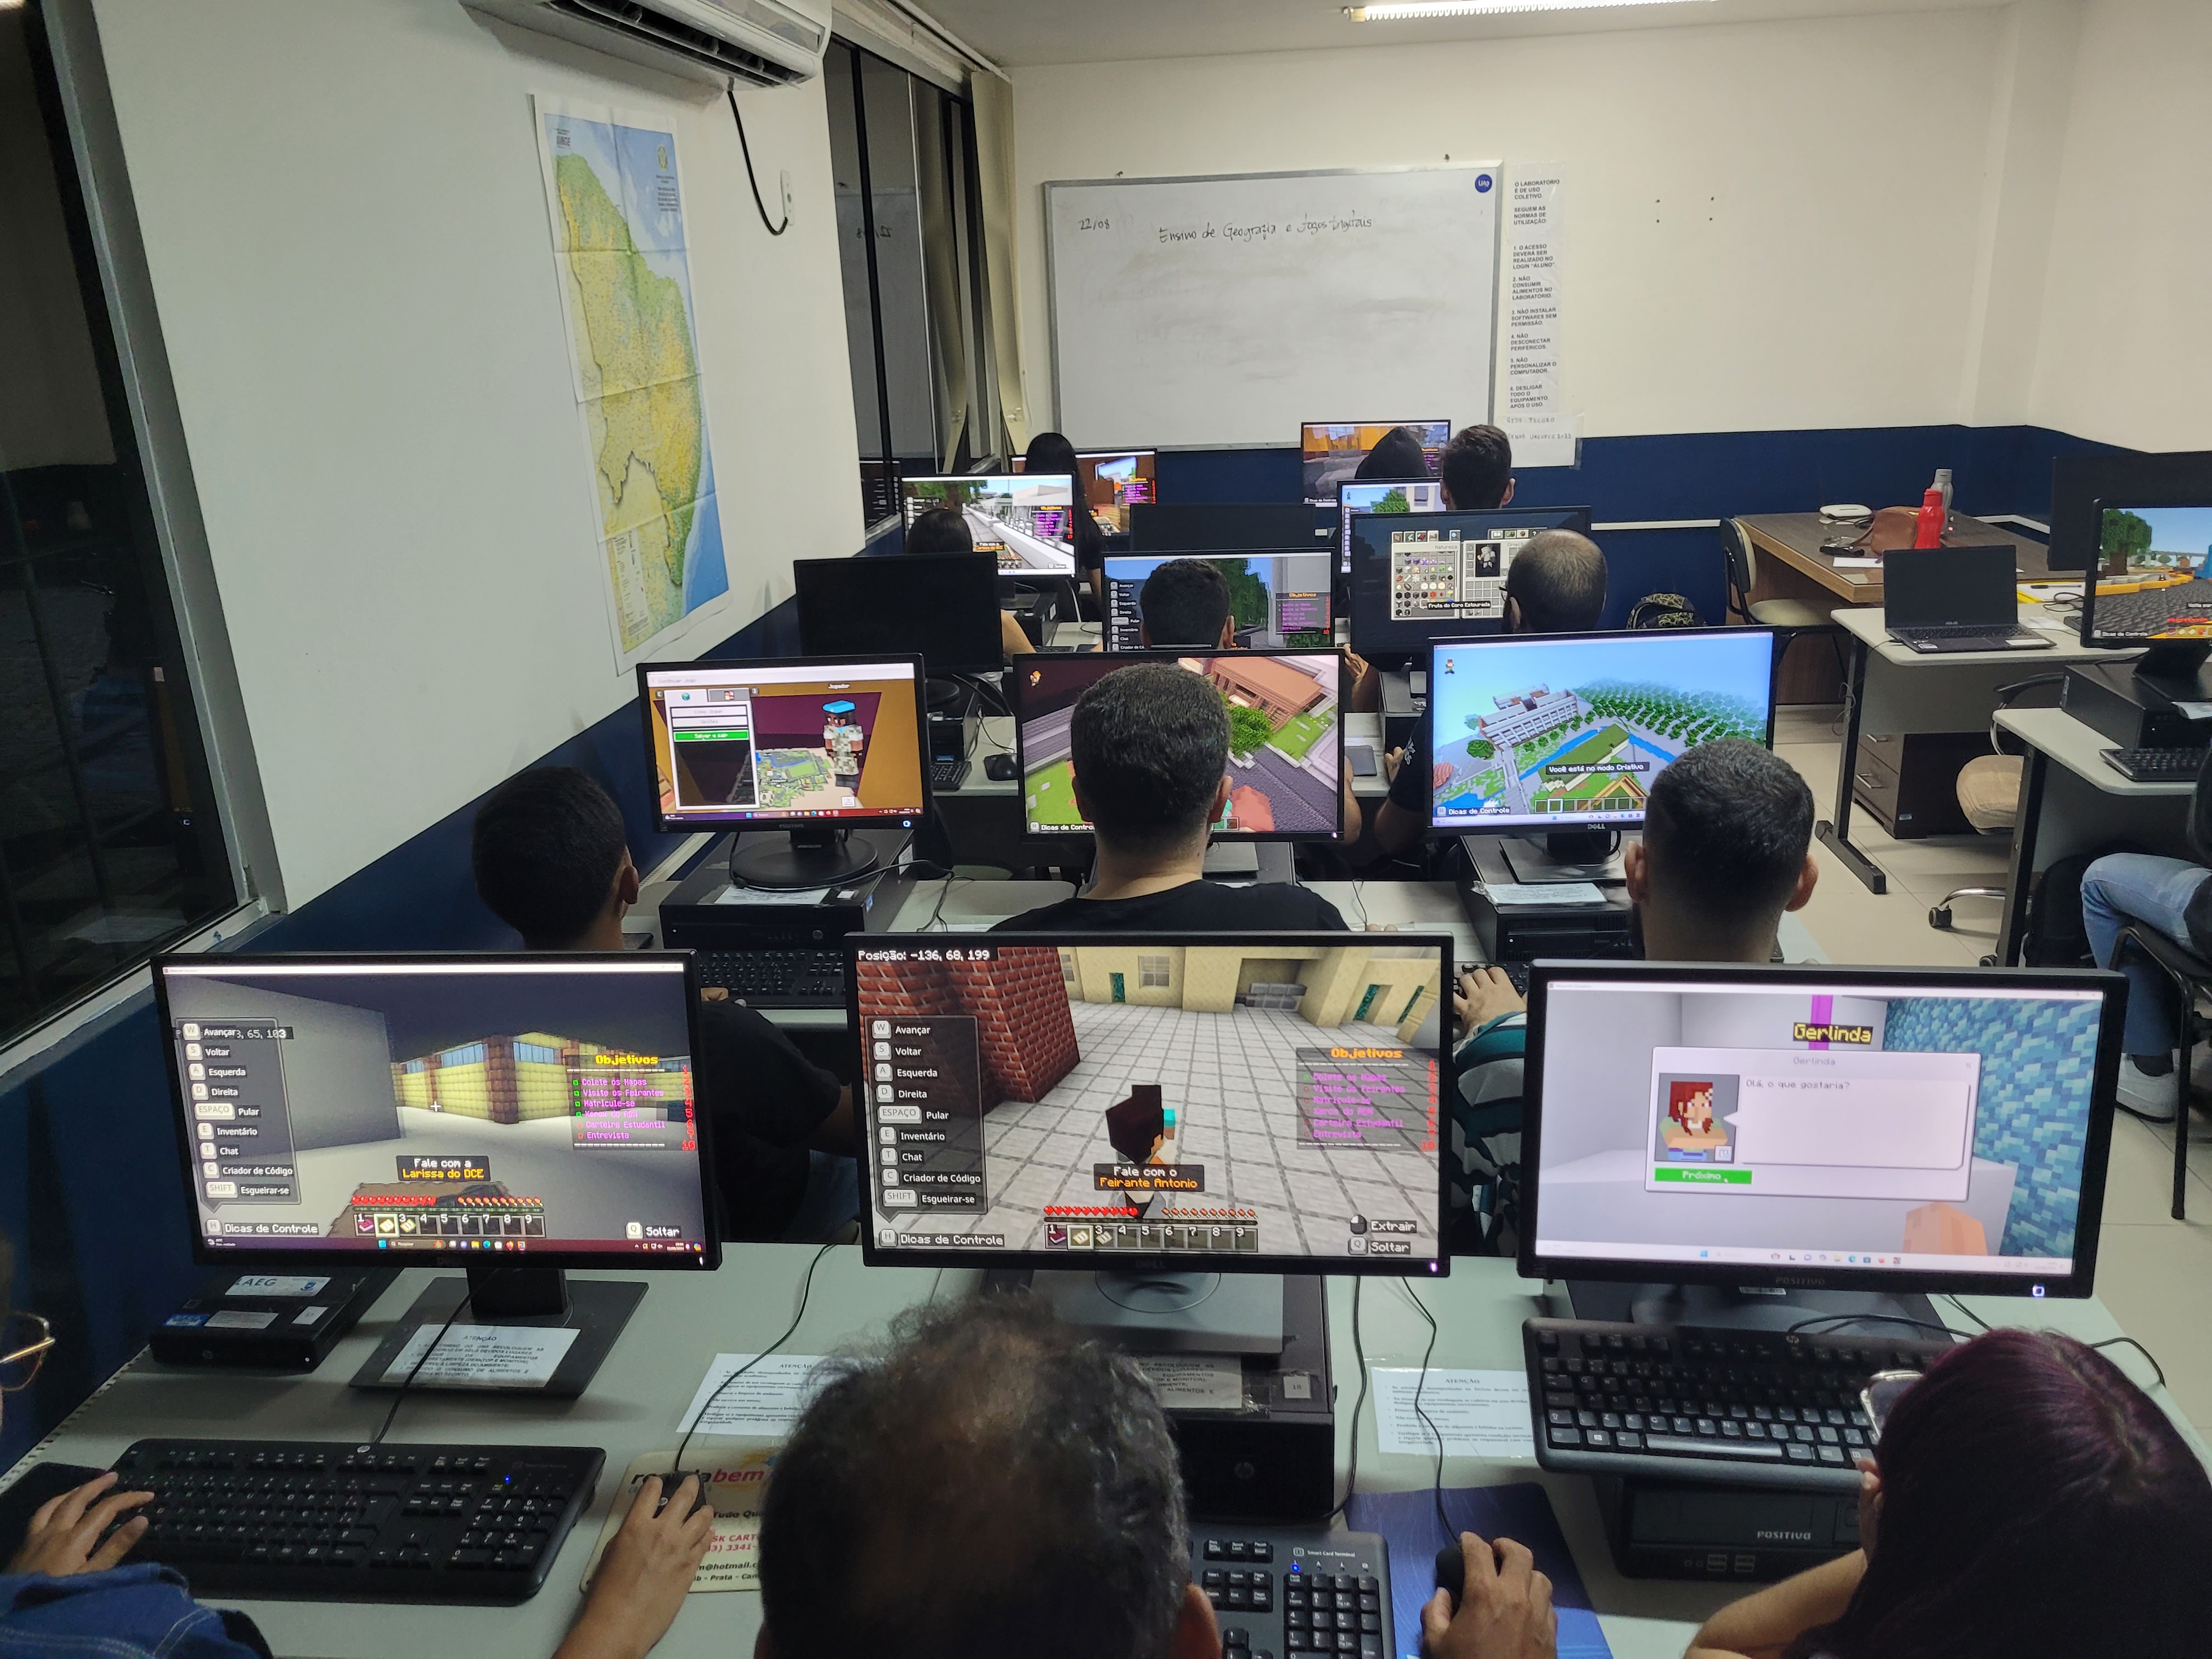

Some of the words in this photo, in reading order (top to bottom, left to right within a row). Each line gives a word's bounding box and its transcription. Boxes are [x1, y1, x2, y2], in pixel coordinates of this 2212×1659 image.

[1079, 218, 1110, 230] 22/08
[1159, 228, 1197, 242] Ensino
[1202, 222, 1216, 238] de
[1223, 222, 1276, 241] Geografia
[858, 950, 906, 961] Posição:
[911, 950, 943, 961] -136,
[946, 950, 963, 961] 68,
[968, 950, 990, 960] 199
[204, 1028, 236, 1037] Avançar
[895, 1026, 930, 1036] Avançar
[1794, 1024, 1871, 1042] Gerlinda
[205, 1047, 230, 1056] Voltar
[1331, 1048, 1402, 1059] Objetivos
[596, 1055, 658, 1065] Objetivos
[208, 1068, 246, 1077] Esquerda
[897, 1069, 938, 1079] Esquerda
[211, 1087, 238, 1096] Direita
[199, 1105, 230, 1115] ESPAÇO
[238, 1107, 259, 1116] Pular
[882, 1109, 916, 1118] ESPAÇO
[217, 1127, 257, 1136] Inventário
[901, 1132, 945, 1141] Inventário
[220, 1147, 239, 1155] Chat
[414, 1158, 437, 1167] Fale
[223, 1166, 251, 1175] Criador
[253, 1166, 263, 1175] de
[265, 1166, 293, 1176] Código
[403, 1169, 444, 1178] Larissa
[448, 1170, 460, 1178] do
[464, 1169, 484, 1178] DCE
[1114, 1167, 1139, 1176] Fale
[950, 1175, 981, 1184] Código
[1683, 1171, 1721, 1181] Próximo
[1100, 1177, 1150, 1188] Feirante
[1154, 1178, 1198, 1188] Antonio
[210, 1184, 232, 1192] SHIFT
[241, 1186, 289, 1196] Esgueirar-se
[922, 1195, 974, 1204] Esgueirar-se
[225, 1224, 252, 1233] Dicas
[256, 1224, 269, 1233] de
[272, 1224, 318, 1233] Controle
[1372, 1221, 1415, 1231] Extrair
[646, 1227, 680, 1238] Soltar
[901, 1235, 931, 1244] Dicas
[935, 1235, 949, 1244] de
[953, 1235, 1003, 1245] Controle
[1372, 1243, 1409, 1252] Soltar
[1757, 1531, 1810, 1540] POSITIVO
